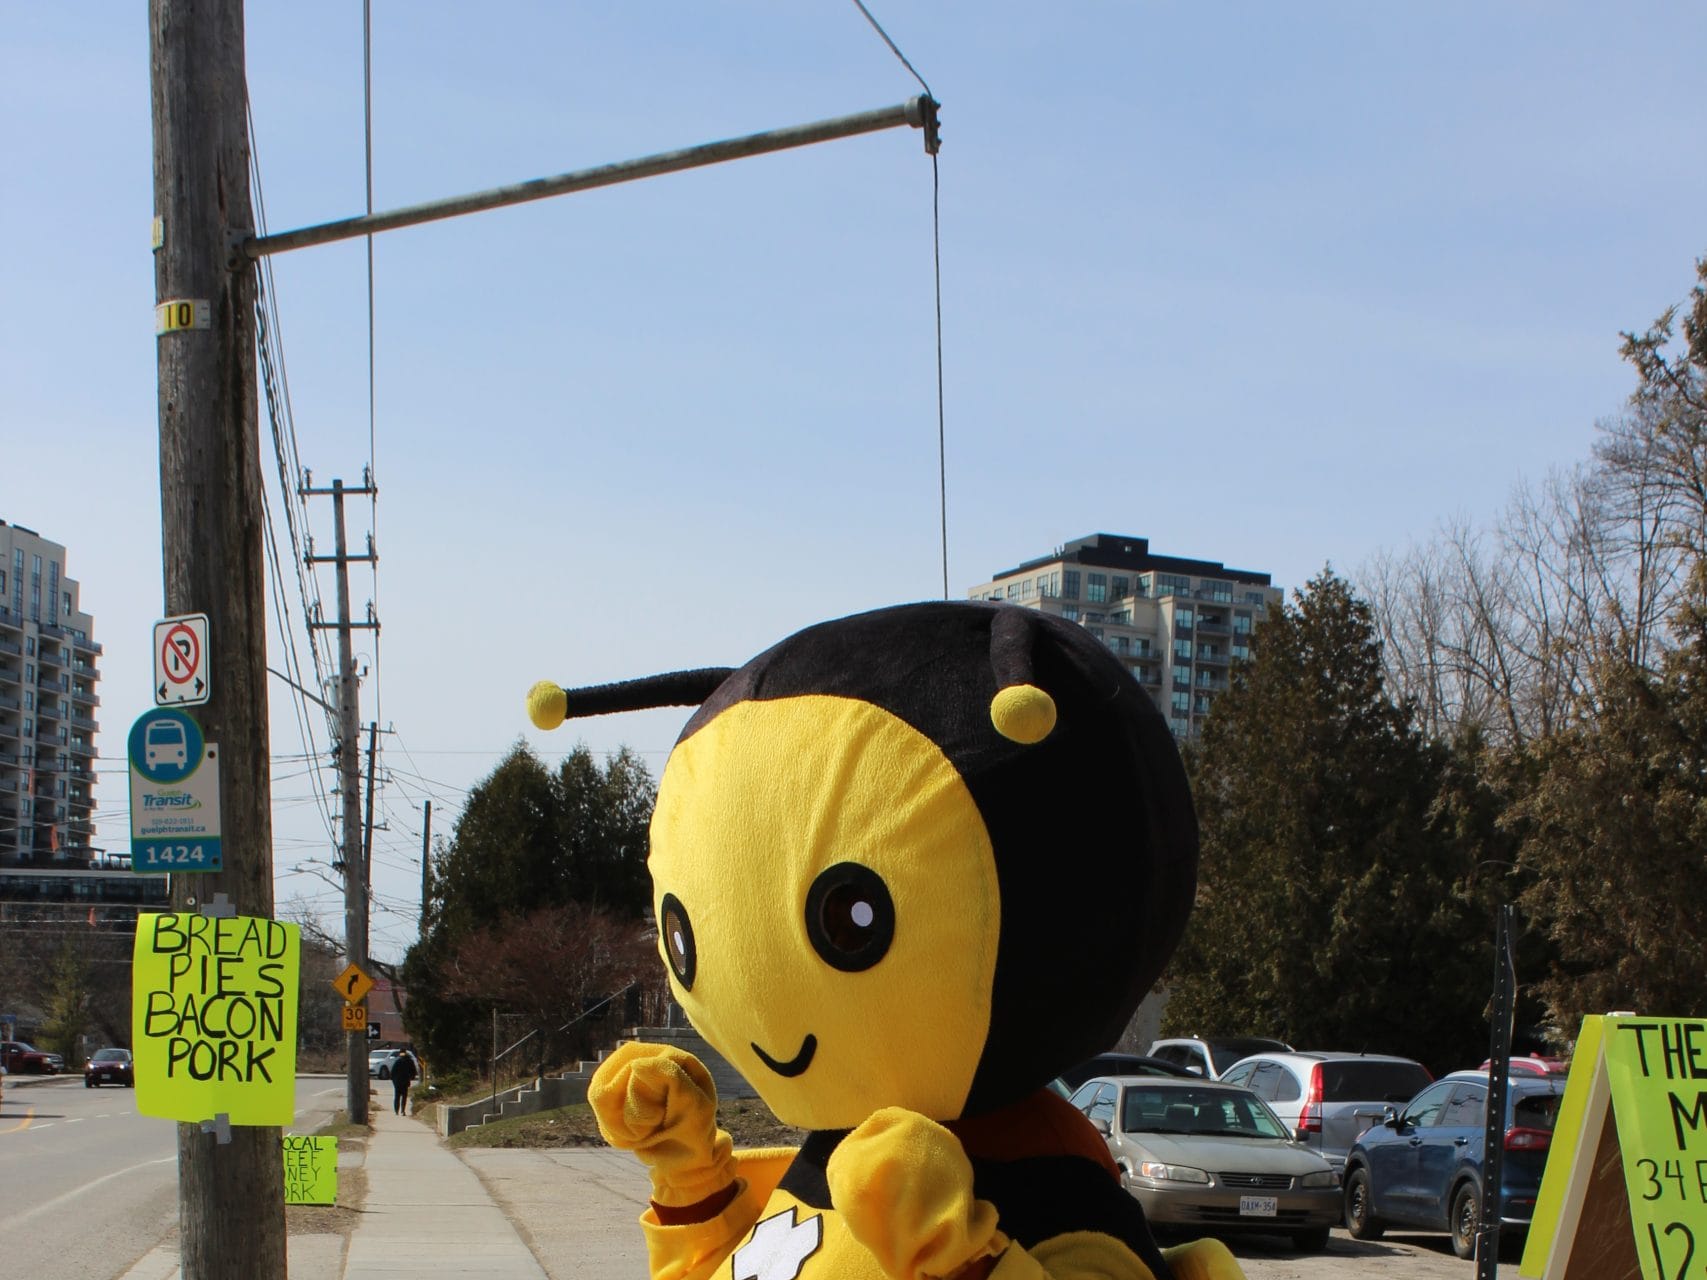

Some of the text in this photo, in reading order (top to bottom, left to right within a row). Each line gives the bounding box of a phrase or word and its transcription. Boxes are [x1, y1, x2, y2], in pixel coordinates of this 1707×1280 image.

[168, 303, 191, 328] 10
[143, 793, 192, 806] Transit
[141, 825, 206, 835] guelphtransit.ca
[146, 846, 205, 864] 1424
[152, 913, 287, 959] BREAD
[169, 953, 285, 998] PIES
[145, 991, 283, 1042] BACON
[346, 1008, 364, 1020] 30
[167, 1037, 276, 1083] PORK
[1617, 1023, 1707, 1080] THE
[282, 1136, 324, 1151] OCAL
[287, 1151, 320, 1167] EEF
[288, 1166, 321, 1182] NEY
[1636, 1158, 1687, 1201] 34
[285, 1182, 315, 1202] RK
